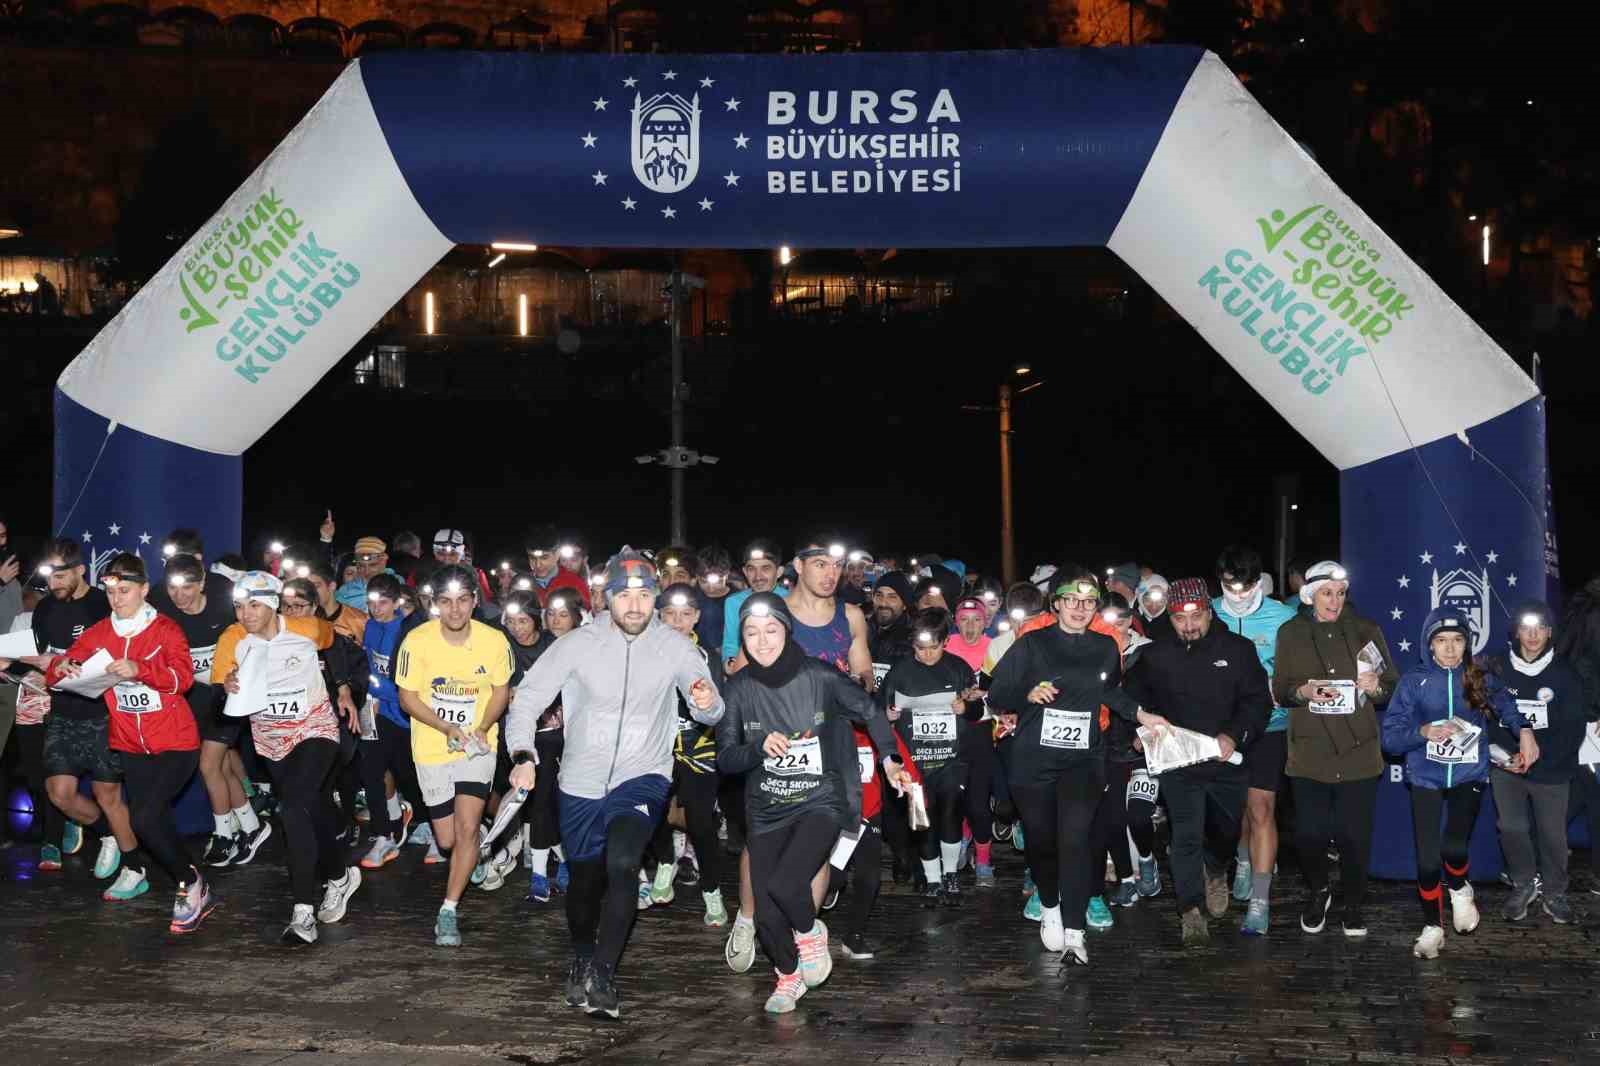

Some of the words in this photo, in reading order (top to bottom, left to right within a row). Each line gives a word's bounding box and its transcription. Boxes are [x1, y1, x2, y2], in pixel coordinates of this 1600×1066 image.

[767, 88, 961, 125] BURSA
[767, 126, 961, 163] BÜYÜKŞEHİR
[767, 161, 961, 193] BELEDİYESİ
[216, 231, 337, 362] GENÇLİK
[235, 260, 361, 384] KULÜBÜ
[1225, 248, 1367, 376] GENÇLİK
[1198, 265, 1333, 395] KULÜBÜ
[122, 692, 150, 707] 108
[269, 701, 299, 714] 174
[437, 707, 466, 723] 016
[921, 722, 948, 735] 032
[1051, 725, 1082, 742] 222
[775, 753, 810, 769] 224
[1133, 781, 1156, 795] 008
